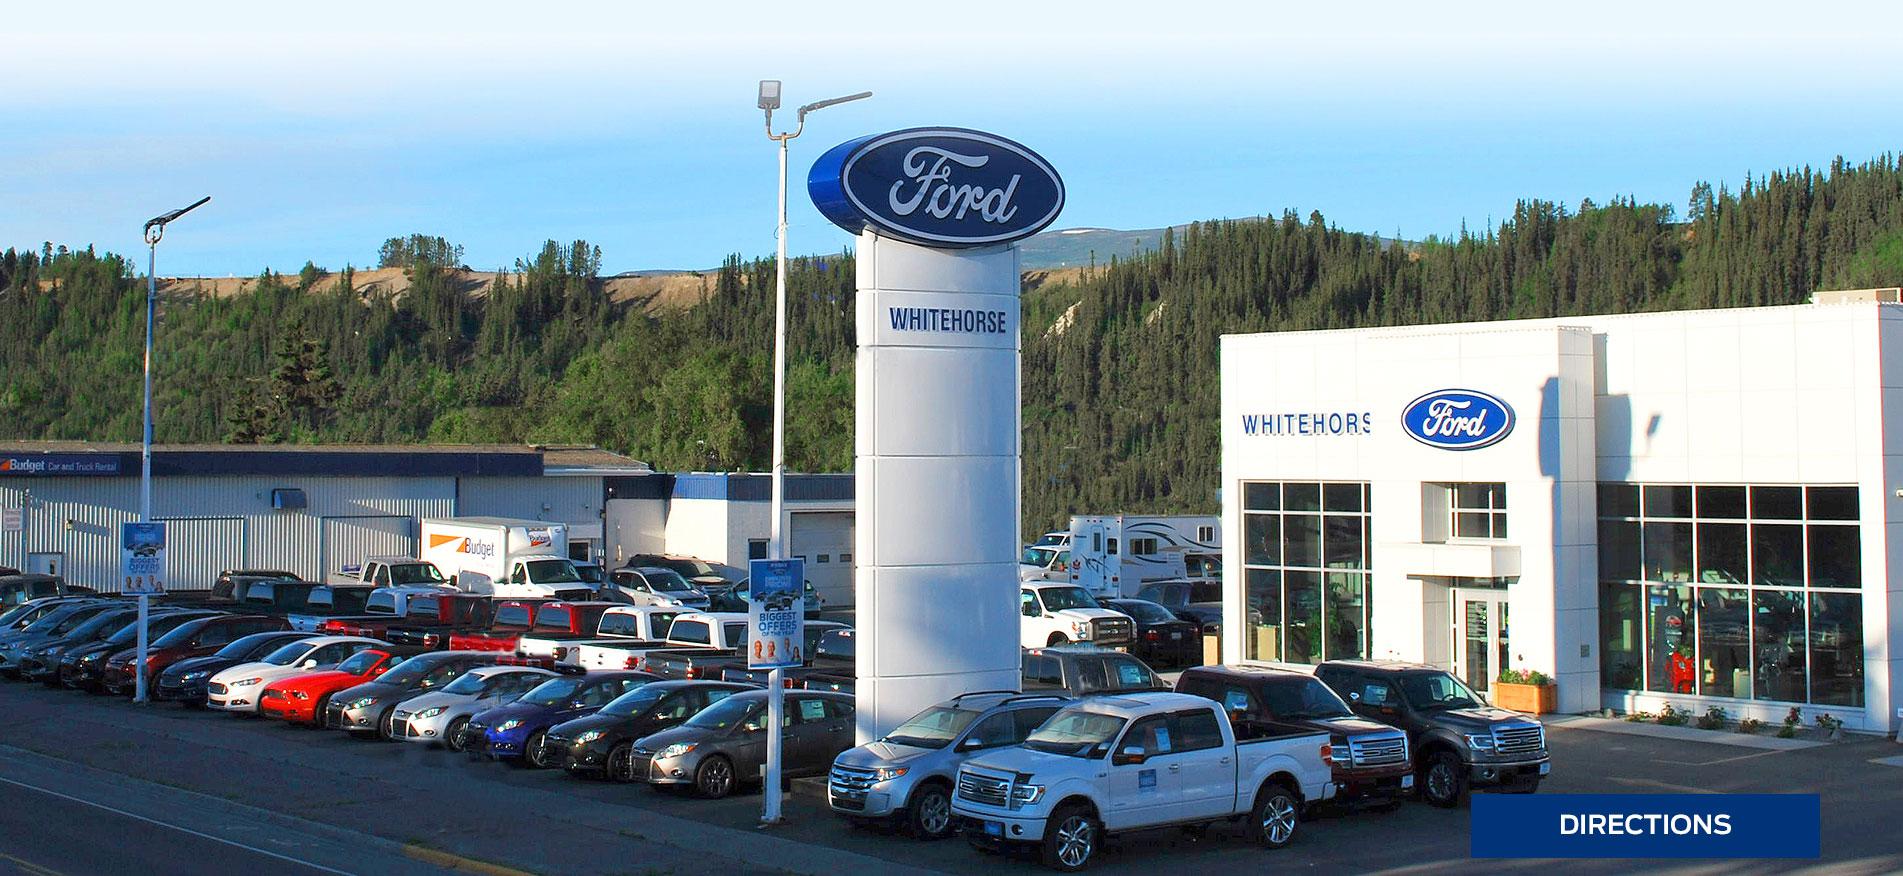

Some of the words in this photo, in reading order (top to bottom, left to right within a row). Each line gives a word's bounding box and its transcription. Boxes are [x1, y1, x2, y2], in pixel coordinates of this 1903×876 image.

[889, 146, 1022, 223] Ford
[889, 307, 1006, 333] WHITEHORSE
[1422, 398, 1488, 437] Ford
[9, 458, 45, 473] Budget
[48, 462, 60, 471] Car
[61, 462, 75, 471] and
[76, 462, 94, 471] Truck
[95, 462, 117, 471] Rental
[464, 537, 495, 560] Budget
[758, 620, 797, 631] OFFERS
[759, 612, 797, 621] BIGGEST
